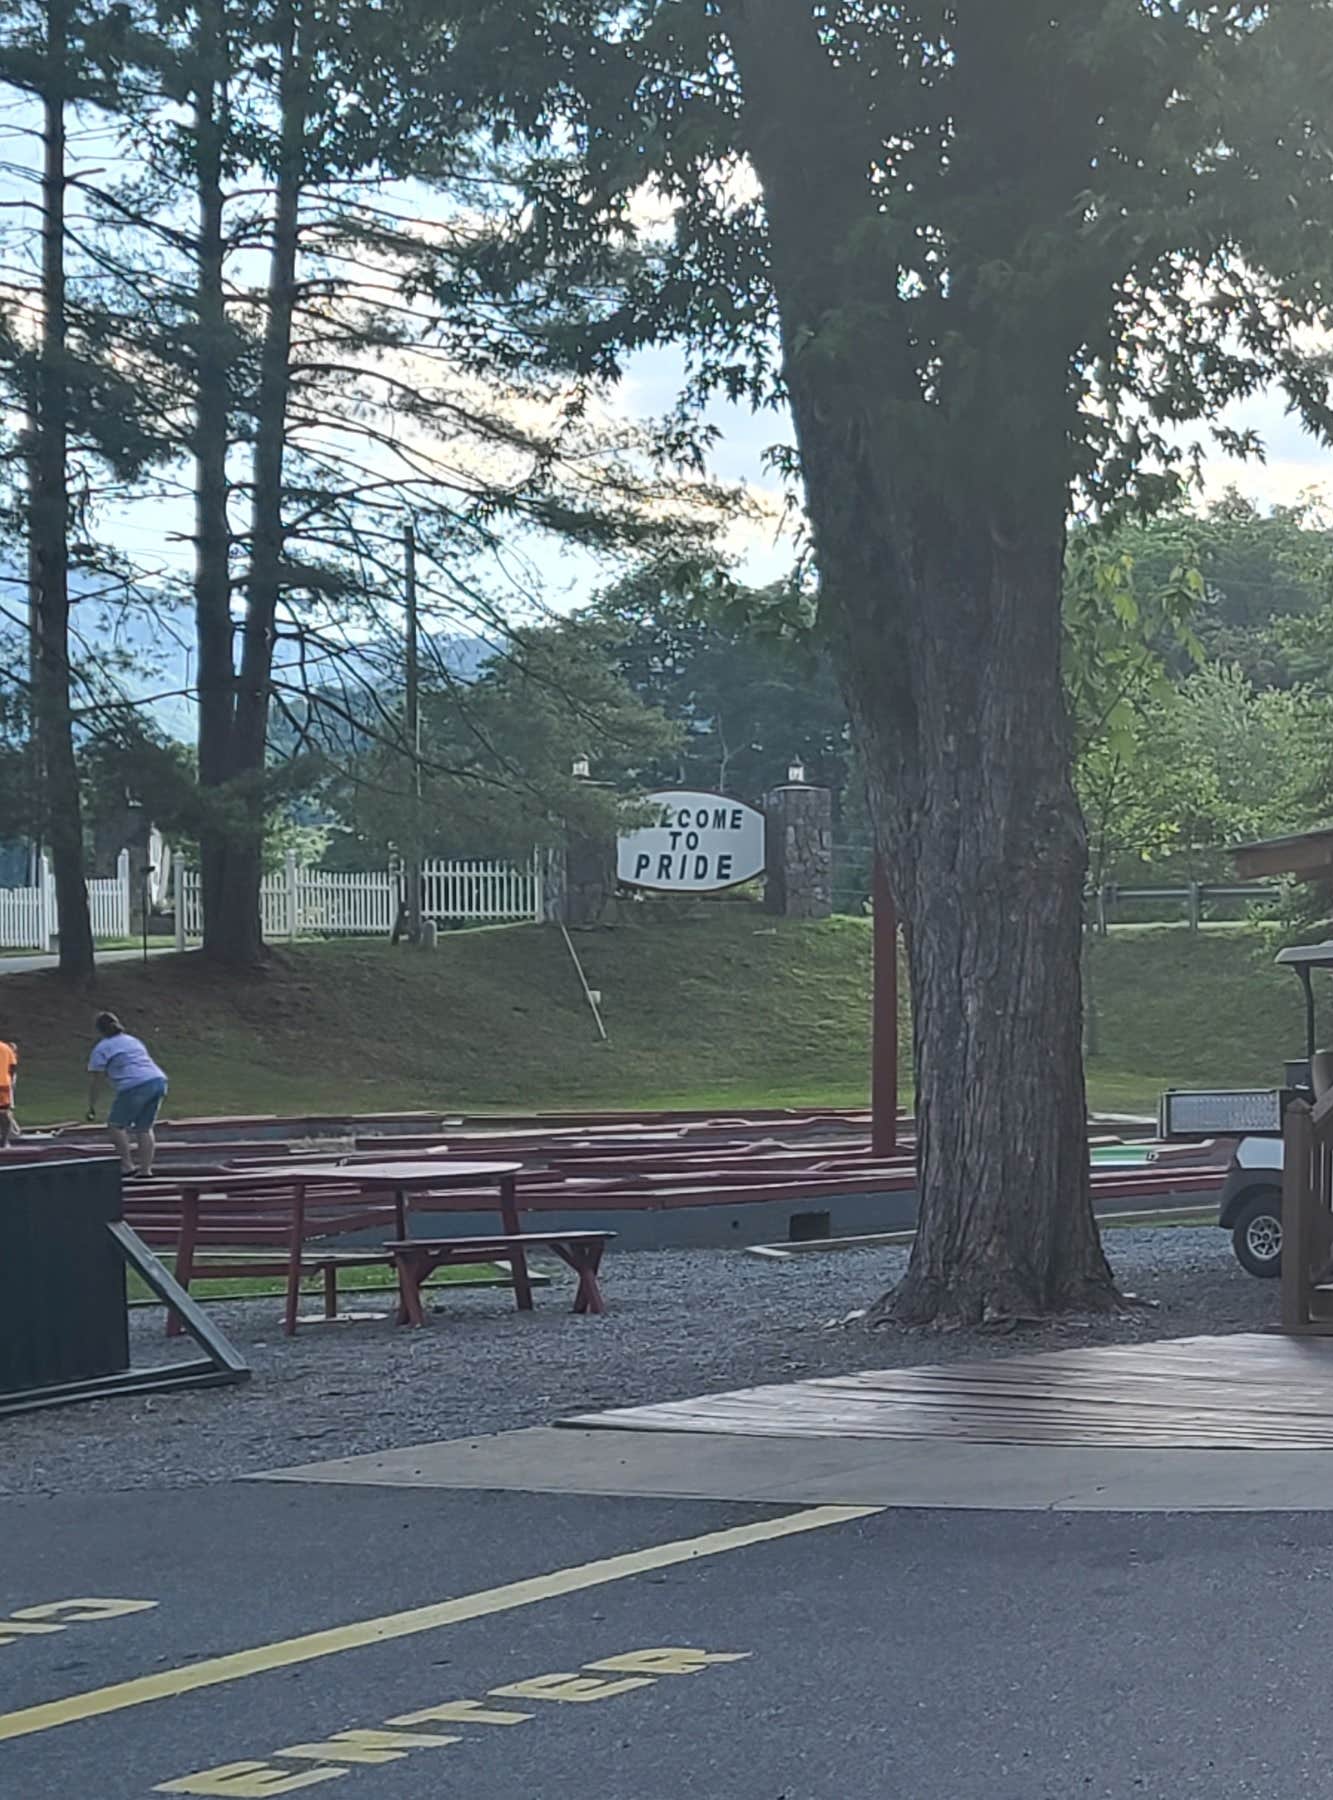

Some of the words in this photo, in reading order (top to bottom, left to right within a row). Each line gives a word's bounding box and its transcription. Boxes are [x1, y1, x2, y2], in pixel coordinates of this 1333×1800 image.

[643, 808, 743, 829] LCOME
[669, 831, 699, 851] TO
[635, 854, 732, 880] PRIDE
[150, 1648, 753, 1798] ENTER
